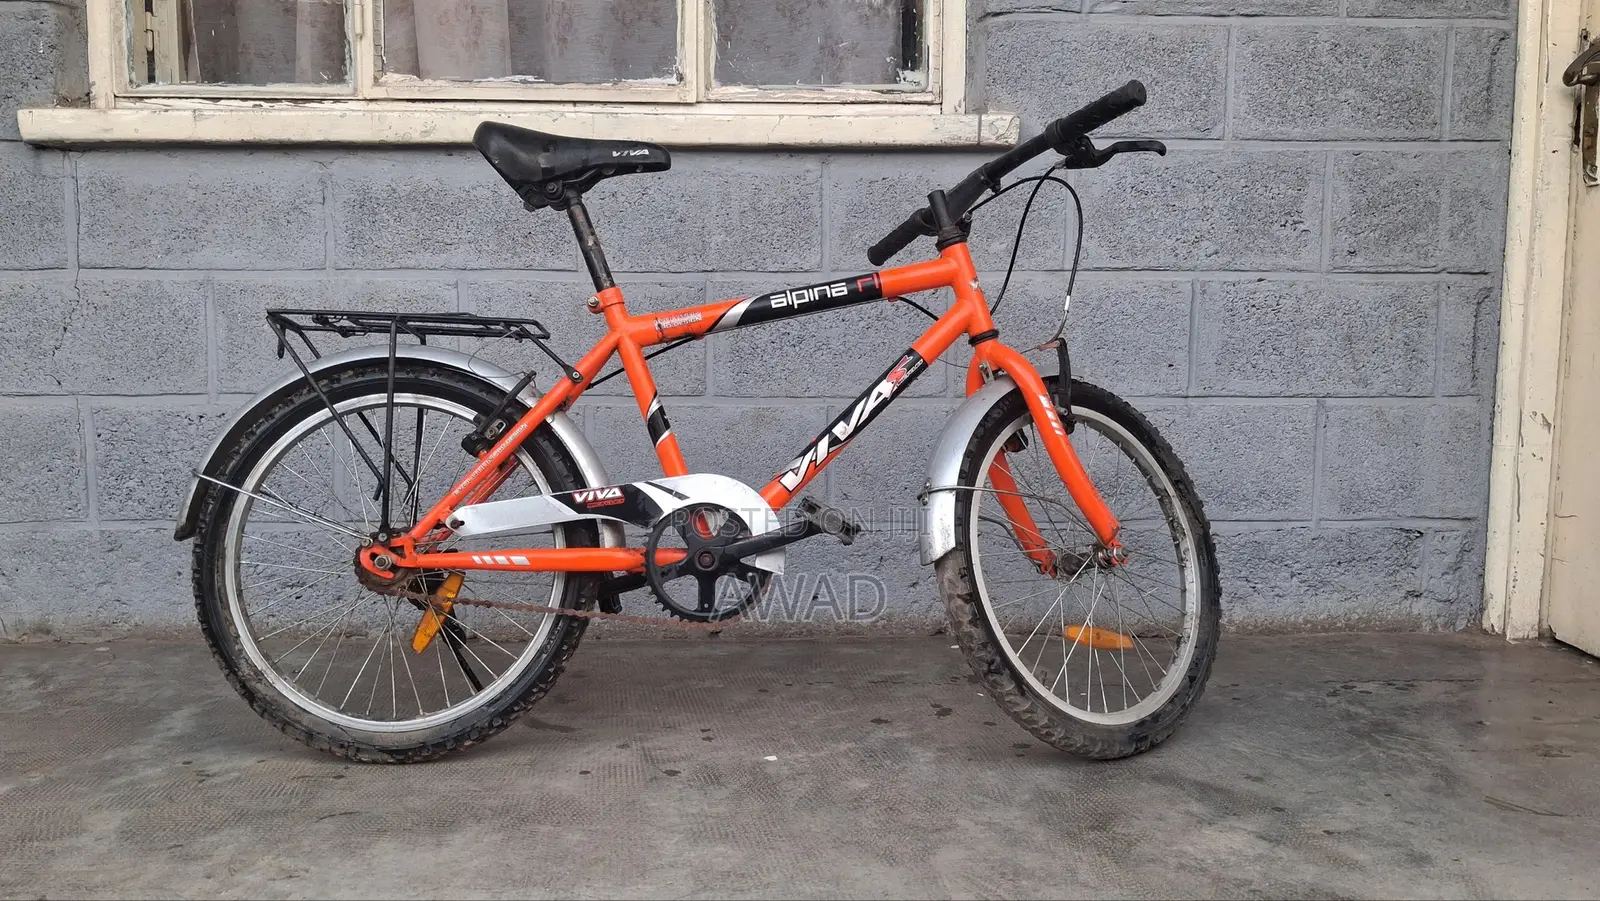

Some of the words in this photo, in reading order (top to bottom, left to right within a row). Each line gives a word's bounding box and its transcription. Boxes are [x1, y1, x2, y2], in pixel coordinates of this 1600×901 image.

[611, 148, 650, 157] VIVA
[769, 282, 848, 309] alpina
[779, 378, 899, 493] VIVA
[572, 486, 623, 504] VIVA
